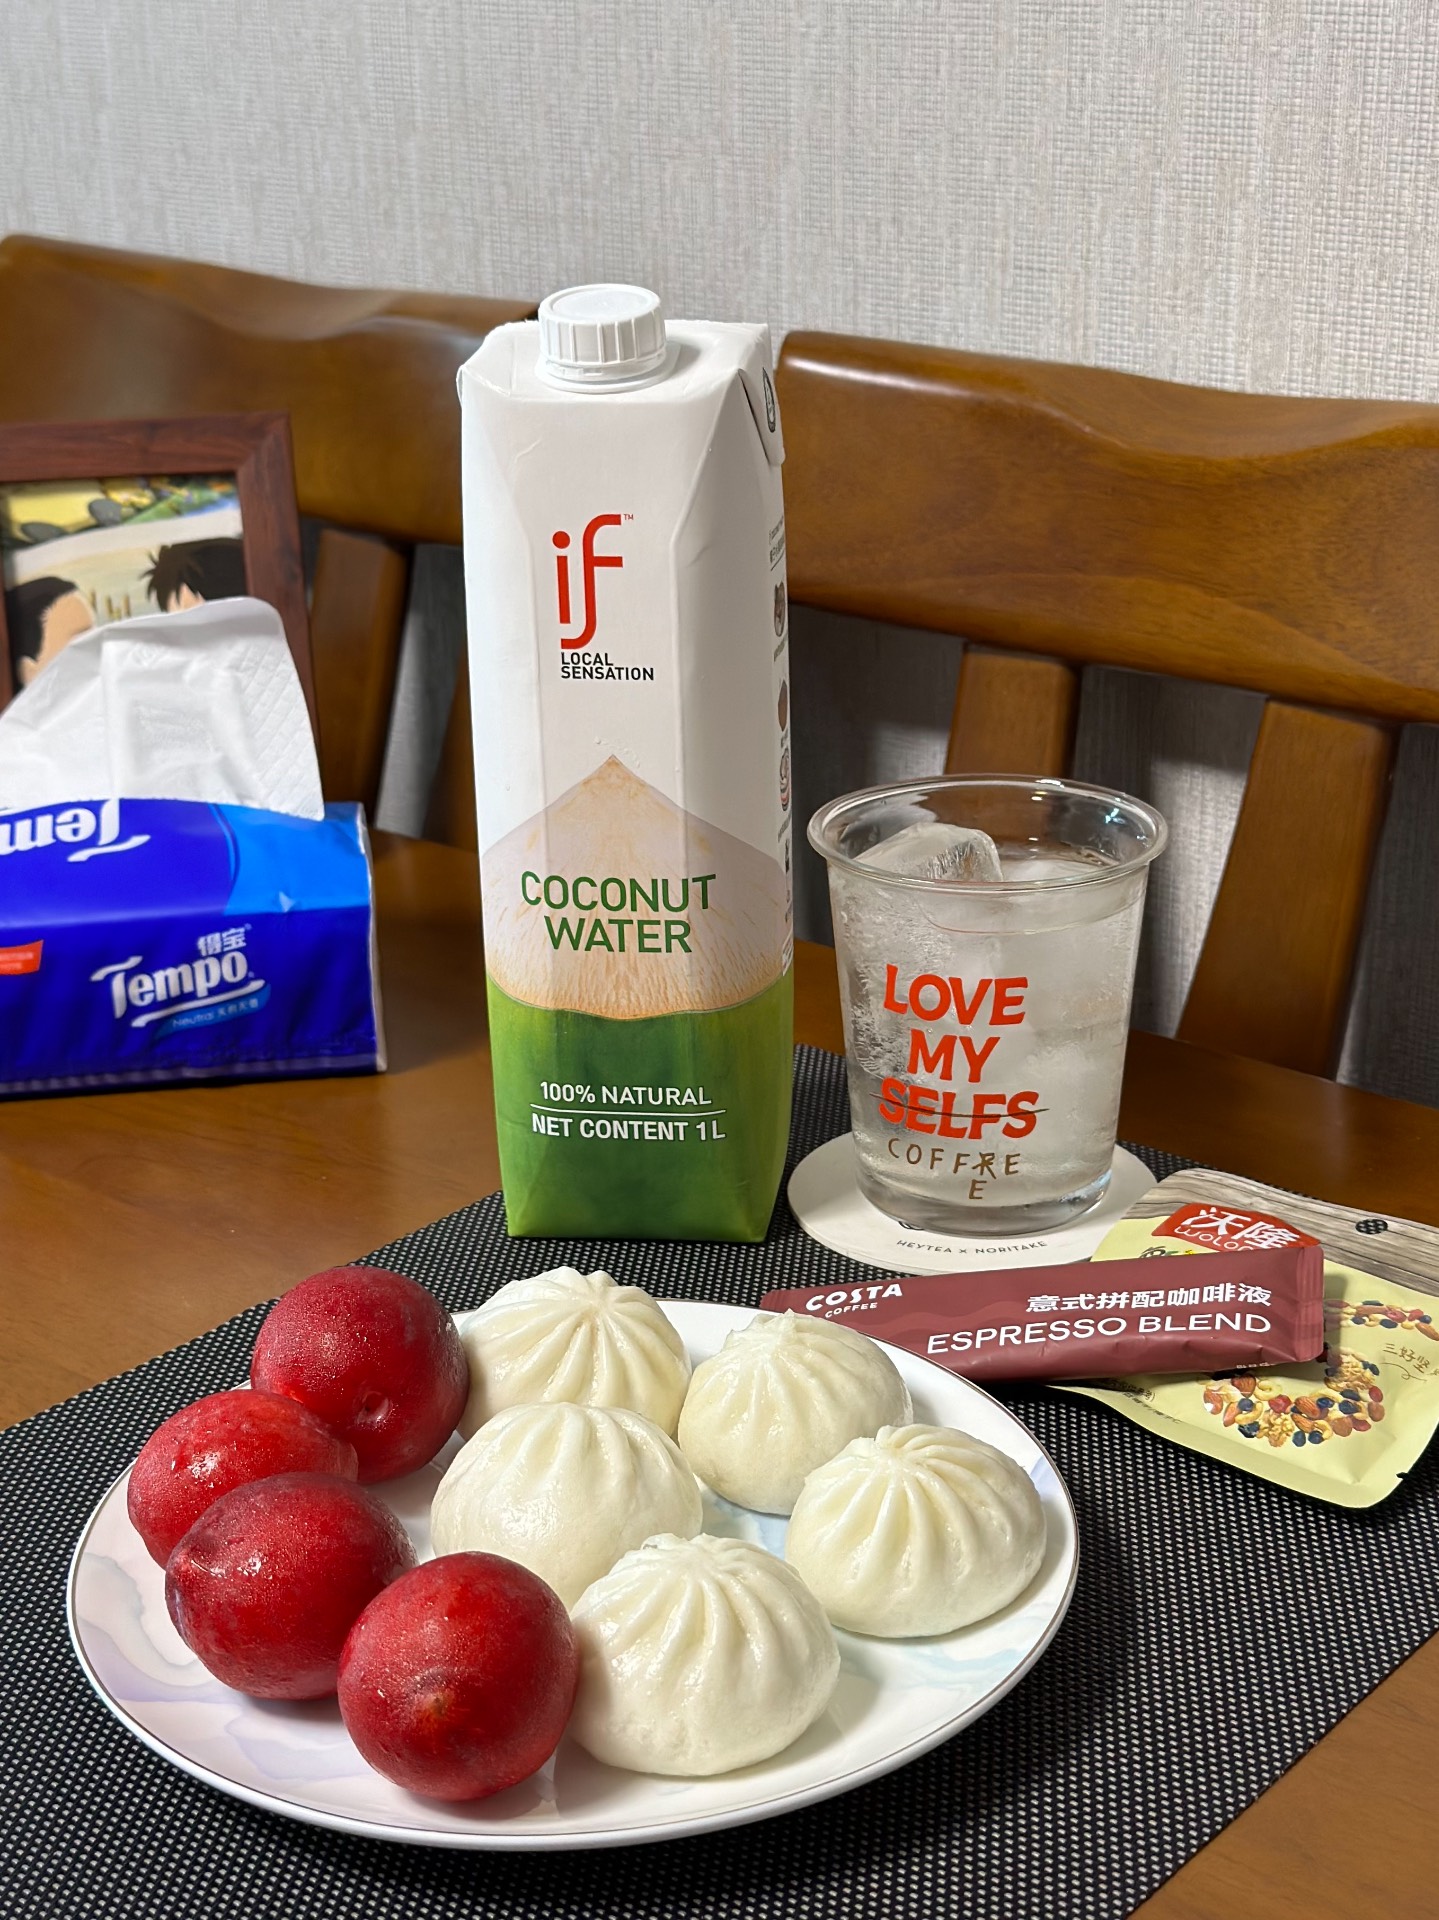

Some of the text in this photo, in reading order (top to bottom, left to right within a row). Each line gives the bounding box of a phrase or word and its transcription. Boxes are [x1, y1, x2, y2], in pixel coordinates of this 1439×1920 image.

[552, 513, 623, 649] if
[561, 652, 614, 666] LOCAL
[561, 666, 654, 681] SENSATION
[521, 871, 717, 912] COCONUT
[197, 927, 247, 957] 得宝
[544, 916, 693, 954] WATER
[90, 950, 249, 1019] Tempo
[883, 963, 1029, 1026] LOVE
[907, 1029, 1001, 1084] MY
[540, 1081, 712, 1106] 100% NATURAL
[878, 1076, 1040, 1140] SELFS
[532, 1112, 574, 1137] NET
[579, 1118, 689, 1141] CONTENT
[1181, 1206, 1300, 1249] 沃隆
[896, 1239, 952, 1254] HEYTEA
[975, 1240, 1048, 1254] NORITAKE
[805, 1283, 903, 1312] COSTA
[825, 1302, 878, 1318] COFFEE
[1025, 1282, 1273, 1313] 意式拼配咖啡液
[926, 1312, 1272, 1355] ESPRESSO BLEND
